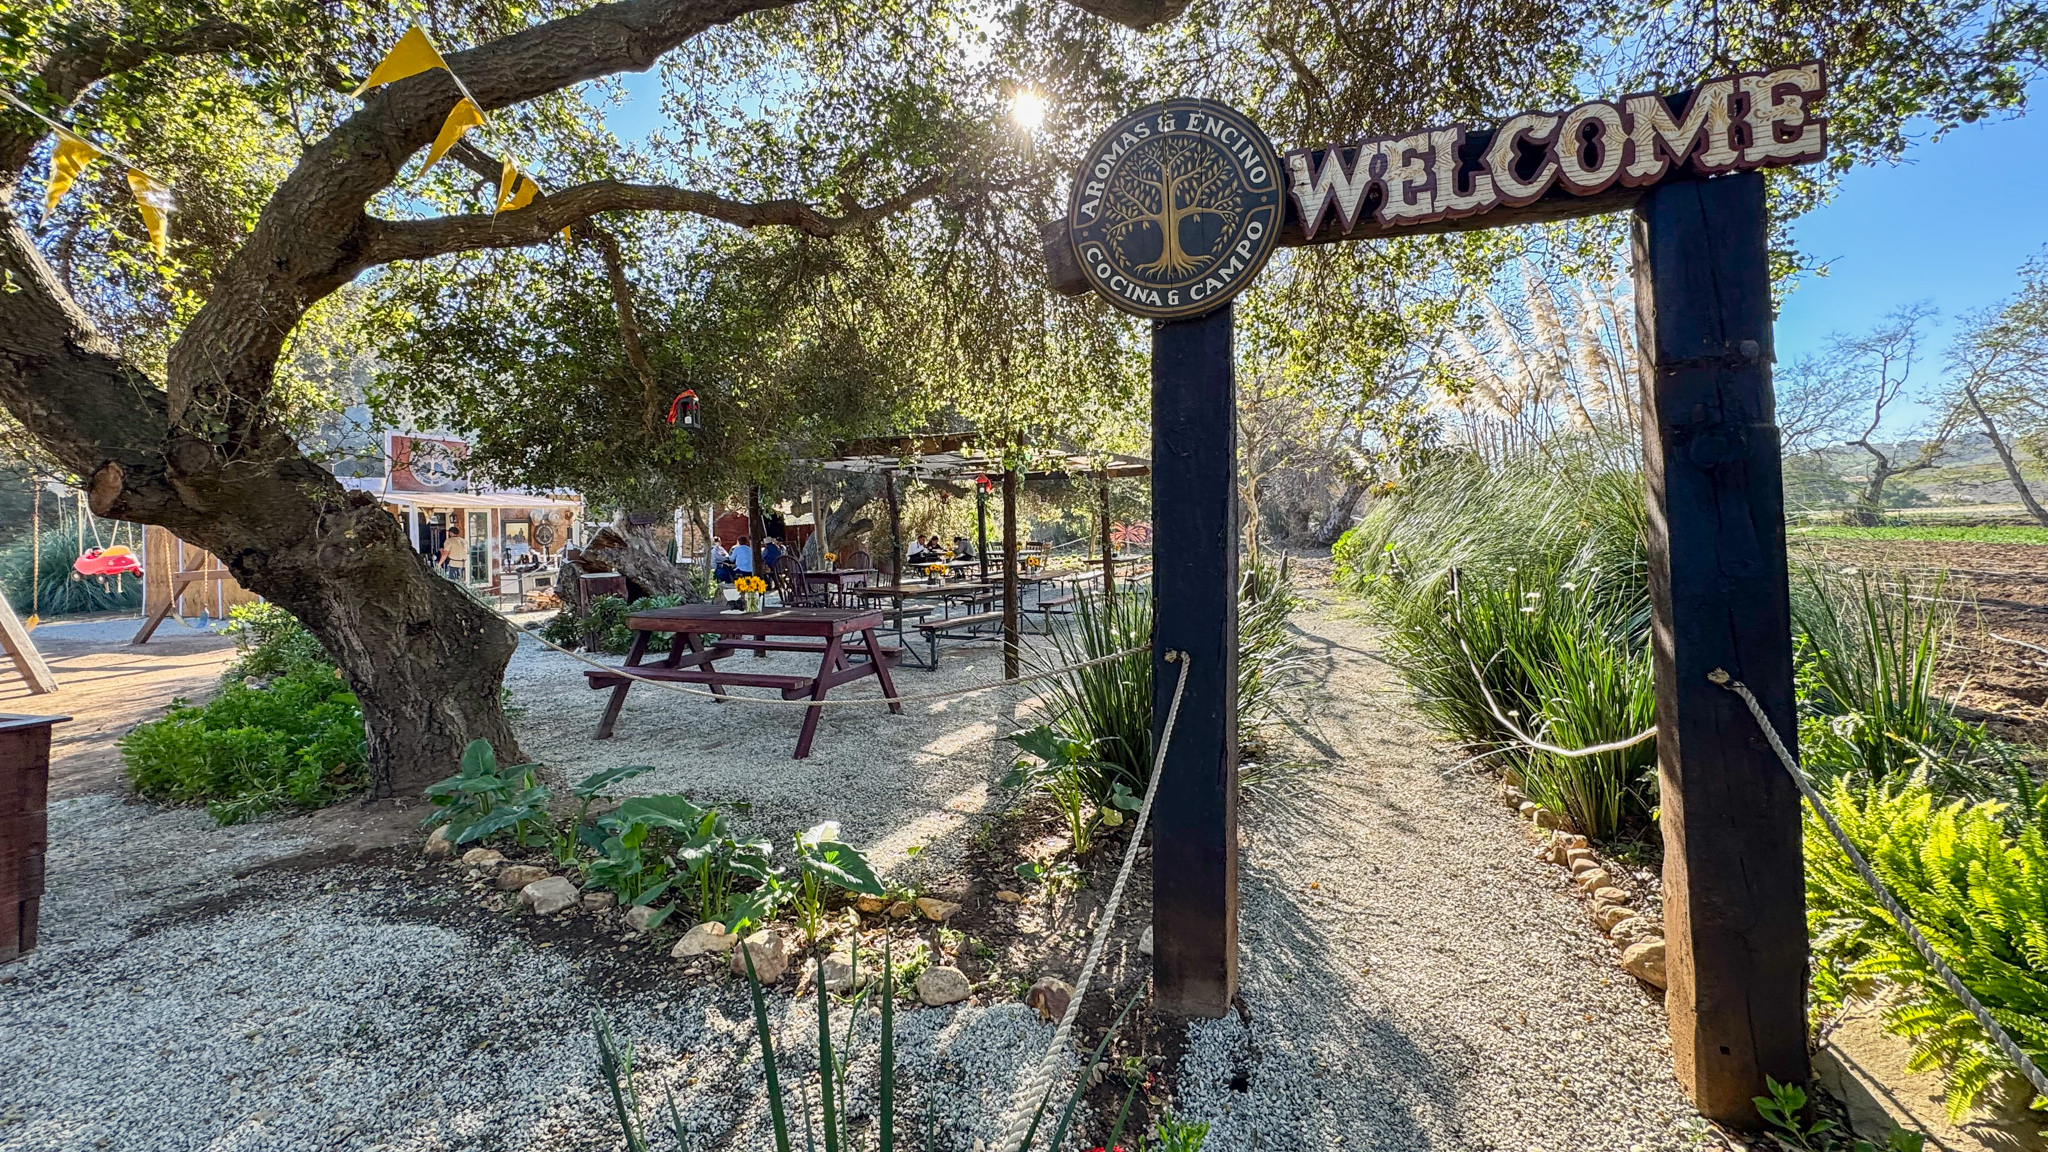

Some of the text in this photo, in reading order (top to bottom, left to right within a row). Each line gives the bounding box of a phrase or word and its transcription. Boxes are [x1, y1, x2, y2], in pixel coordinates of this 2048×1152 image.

[1081, 113, 1267, 217] AROMAS & ENCINO
[1286, 62, 1826, 239] WELCOME
[1086, 221, 1263, 307] COCINA & CAMPO
